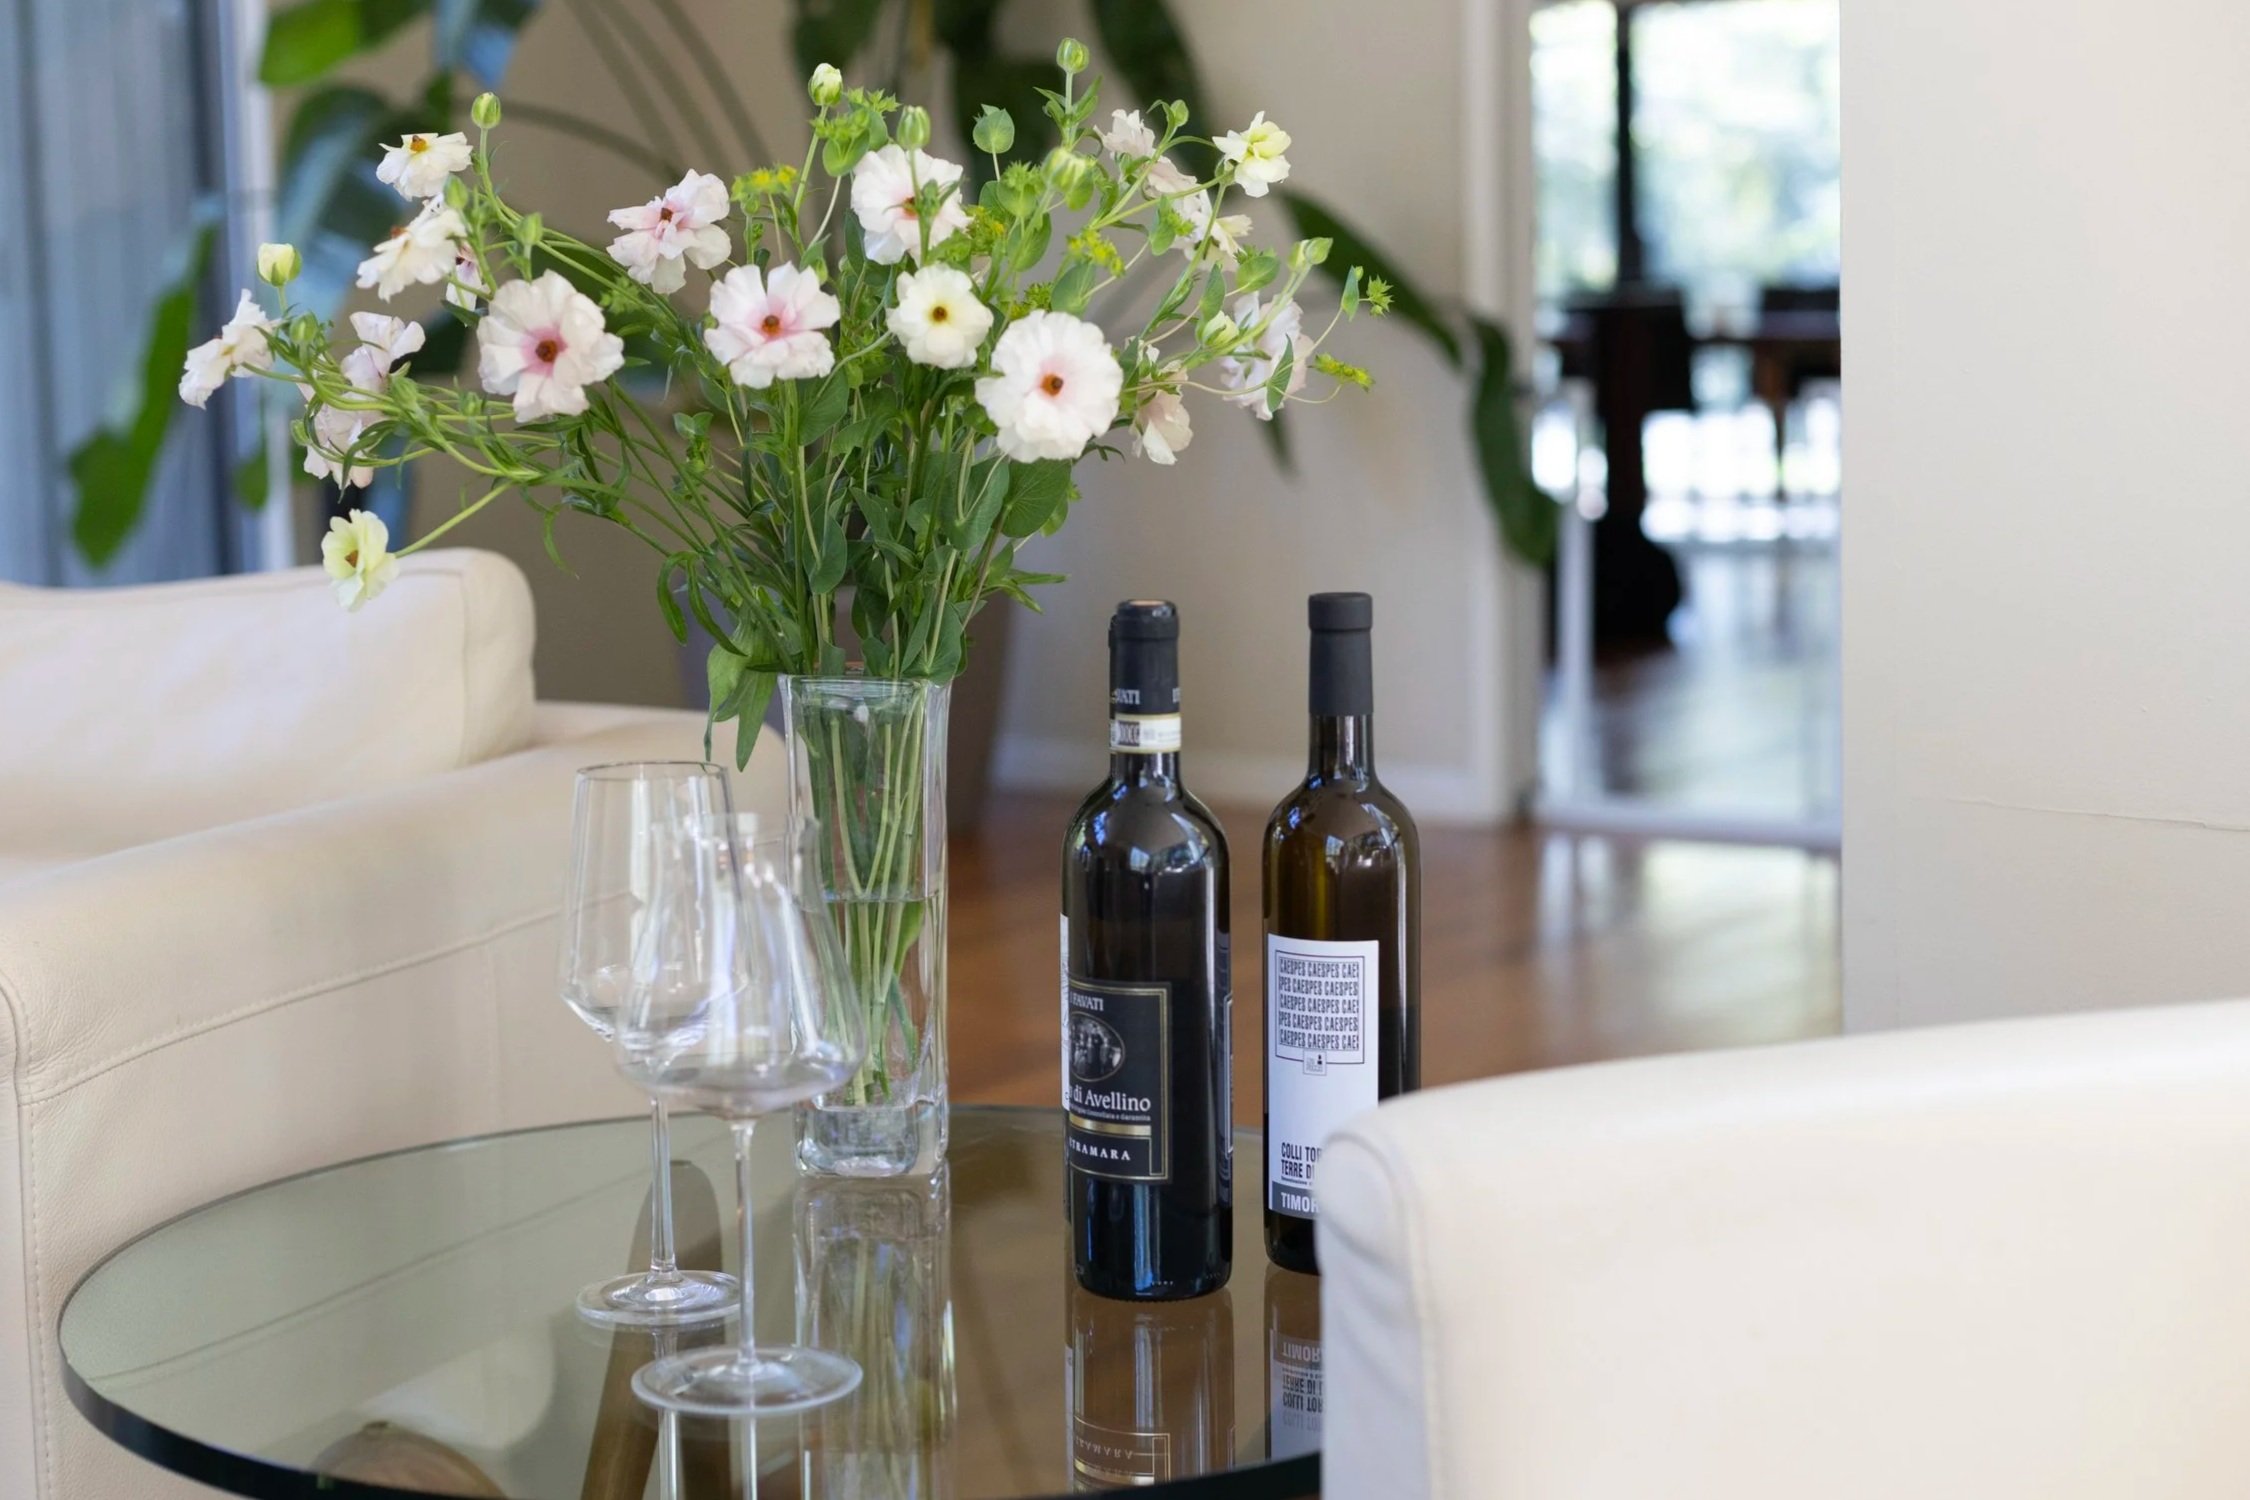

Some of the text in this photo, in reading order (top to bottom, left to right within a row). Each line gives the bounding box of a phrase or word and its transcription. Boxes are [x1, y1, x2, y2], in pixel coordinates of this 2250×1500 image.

[1279, 958, 1306, 977] CAESPES
[1307, 961, 1340, 978] CAESPES
[1292, 978, 1322, 996] CAESPES
[1324, 981, 1359, 996] CAESPES
[1279, 993, 1306, 1012] CAESPES
[1307, 997, 1340, 1014] CAESPES
[1292, 1013, 1322, 1031] CAESPES
[1324, 1016, 1359, 1032] CAESPES
[1279, 1029, 1306, 1047] CAESPES
[1307, 1032, 1340, 1049] CAESPES
[1073, 1084, 1083, 1104] di
[1084, 1089, 1152, 1112] Avellino
[1069, 1136, 1131, 1162] ETRAMARA
[1281, 1142, 1302, 1161] COLLI
[1281, 1159, 1303, 1178] TERRE
